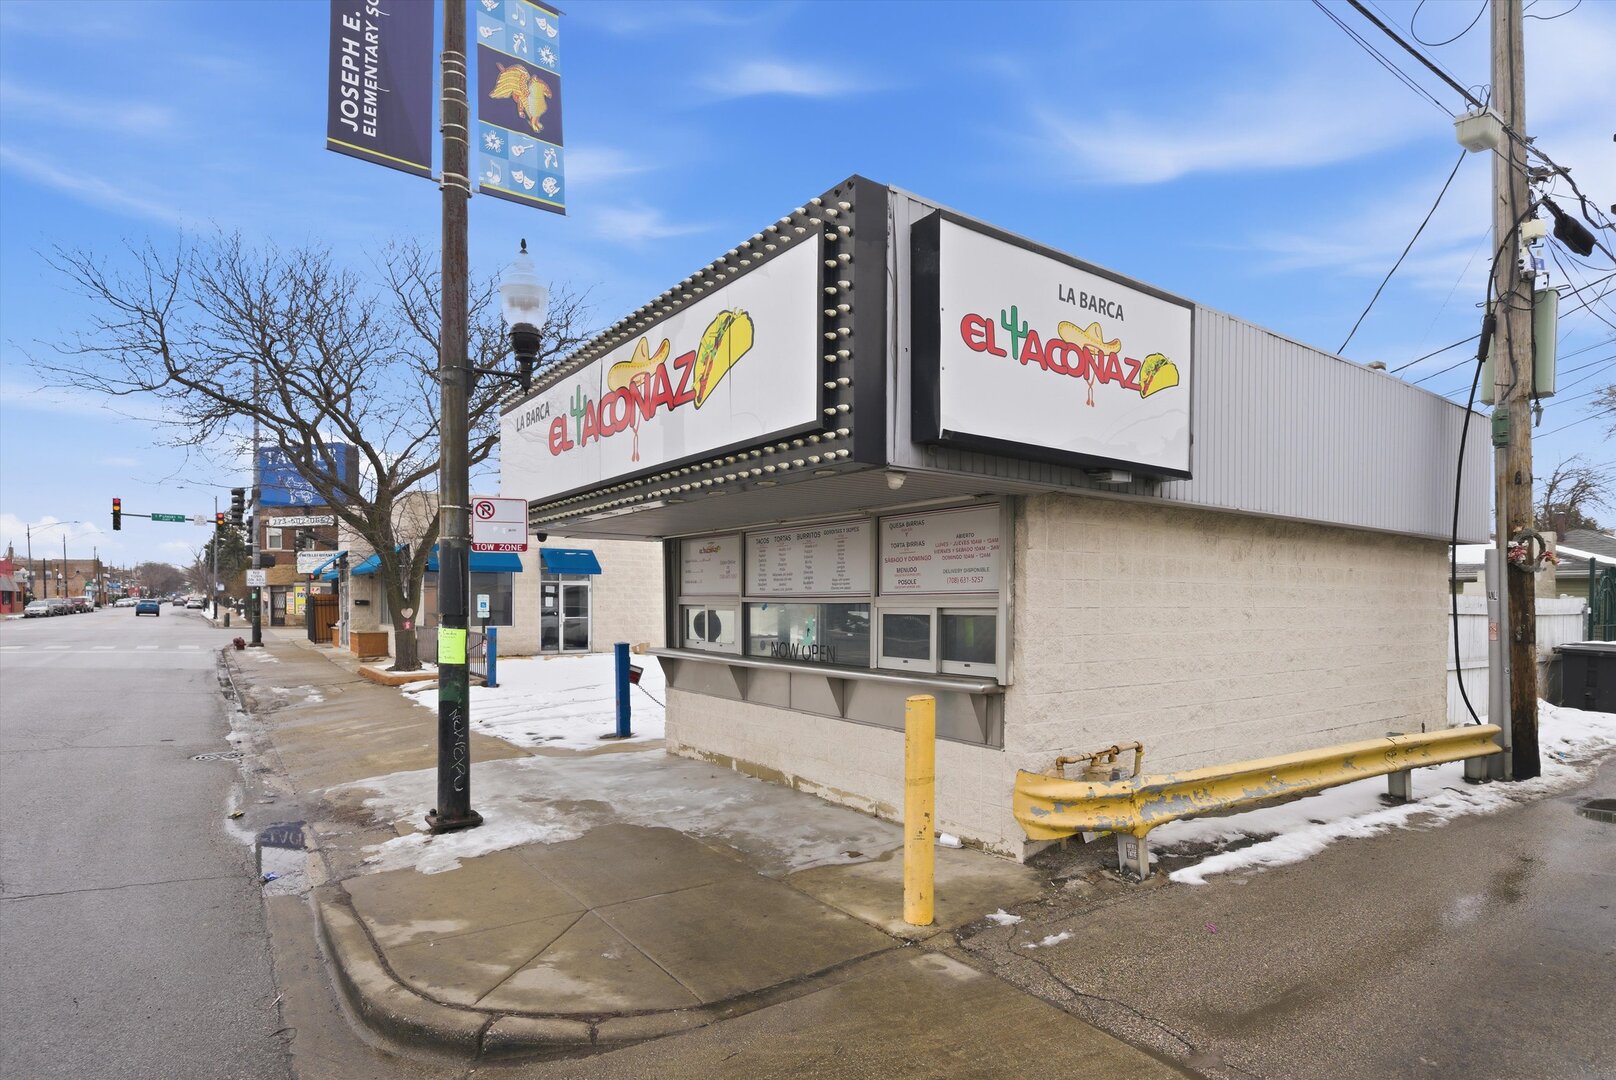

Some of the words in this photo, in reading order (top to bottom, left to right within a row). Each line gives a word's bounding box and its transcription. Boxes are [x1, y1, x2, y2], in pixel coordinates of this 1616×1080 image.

[342, 11, 361, 32] E.
[340, 37, 360, 132] JOSEPH
[363, 20, 379, 137] ELEMENTARY
[1058, 284, 1076, 305] LA
[1080, 292, 1125, 321] BARCA
[960, 313, 1007, 357] EL
[516, 414, 526, 432] LA
[525, 401, 550, 428] BARCA
[549, 413, 574, 456] EL
[756, 537, 770, 545] TACOS
[796, 531, 821, 540] BURRITOS
[889, 522, 905, 530] QUESA
[771, 641, 799, 660] NOW
[802, 644, 836, 663] OPEN
